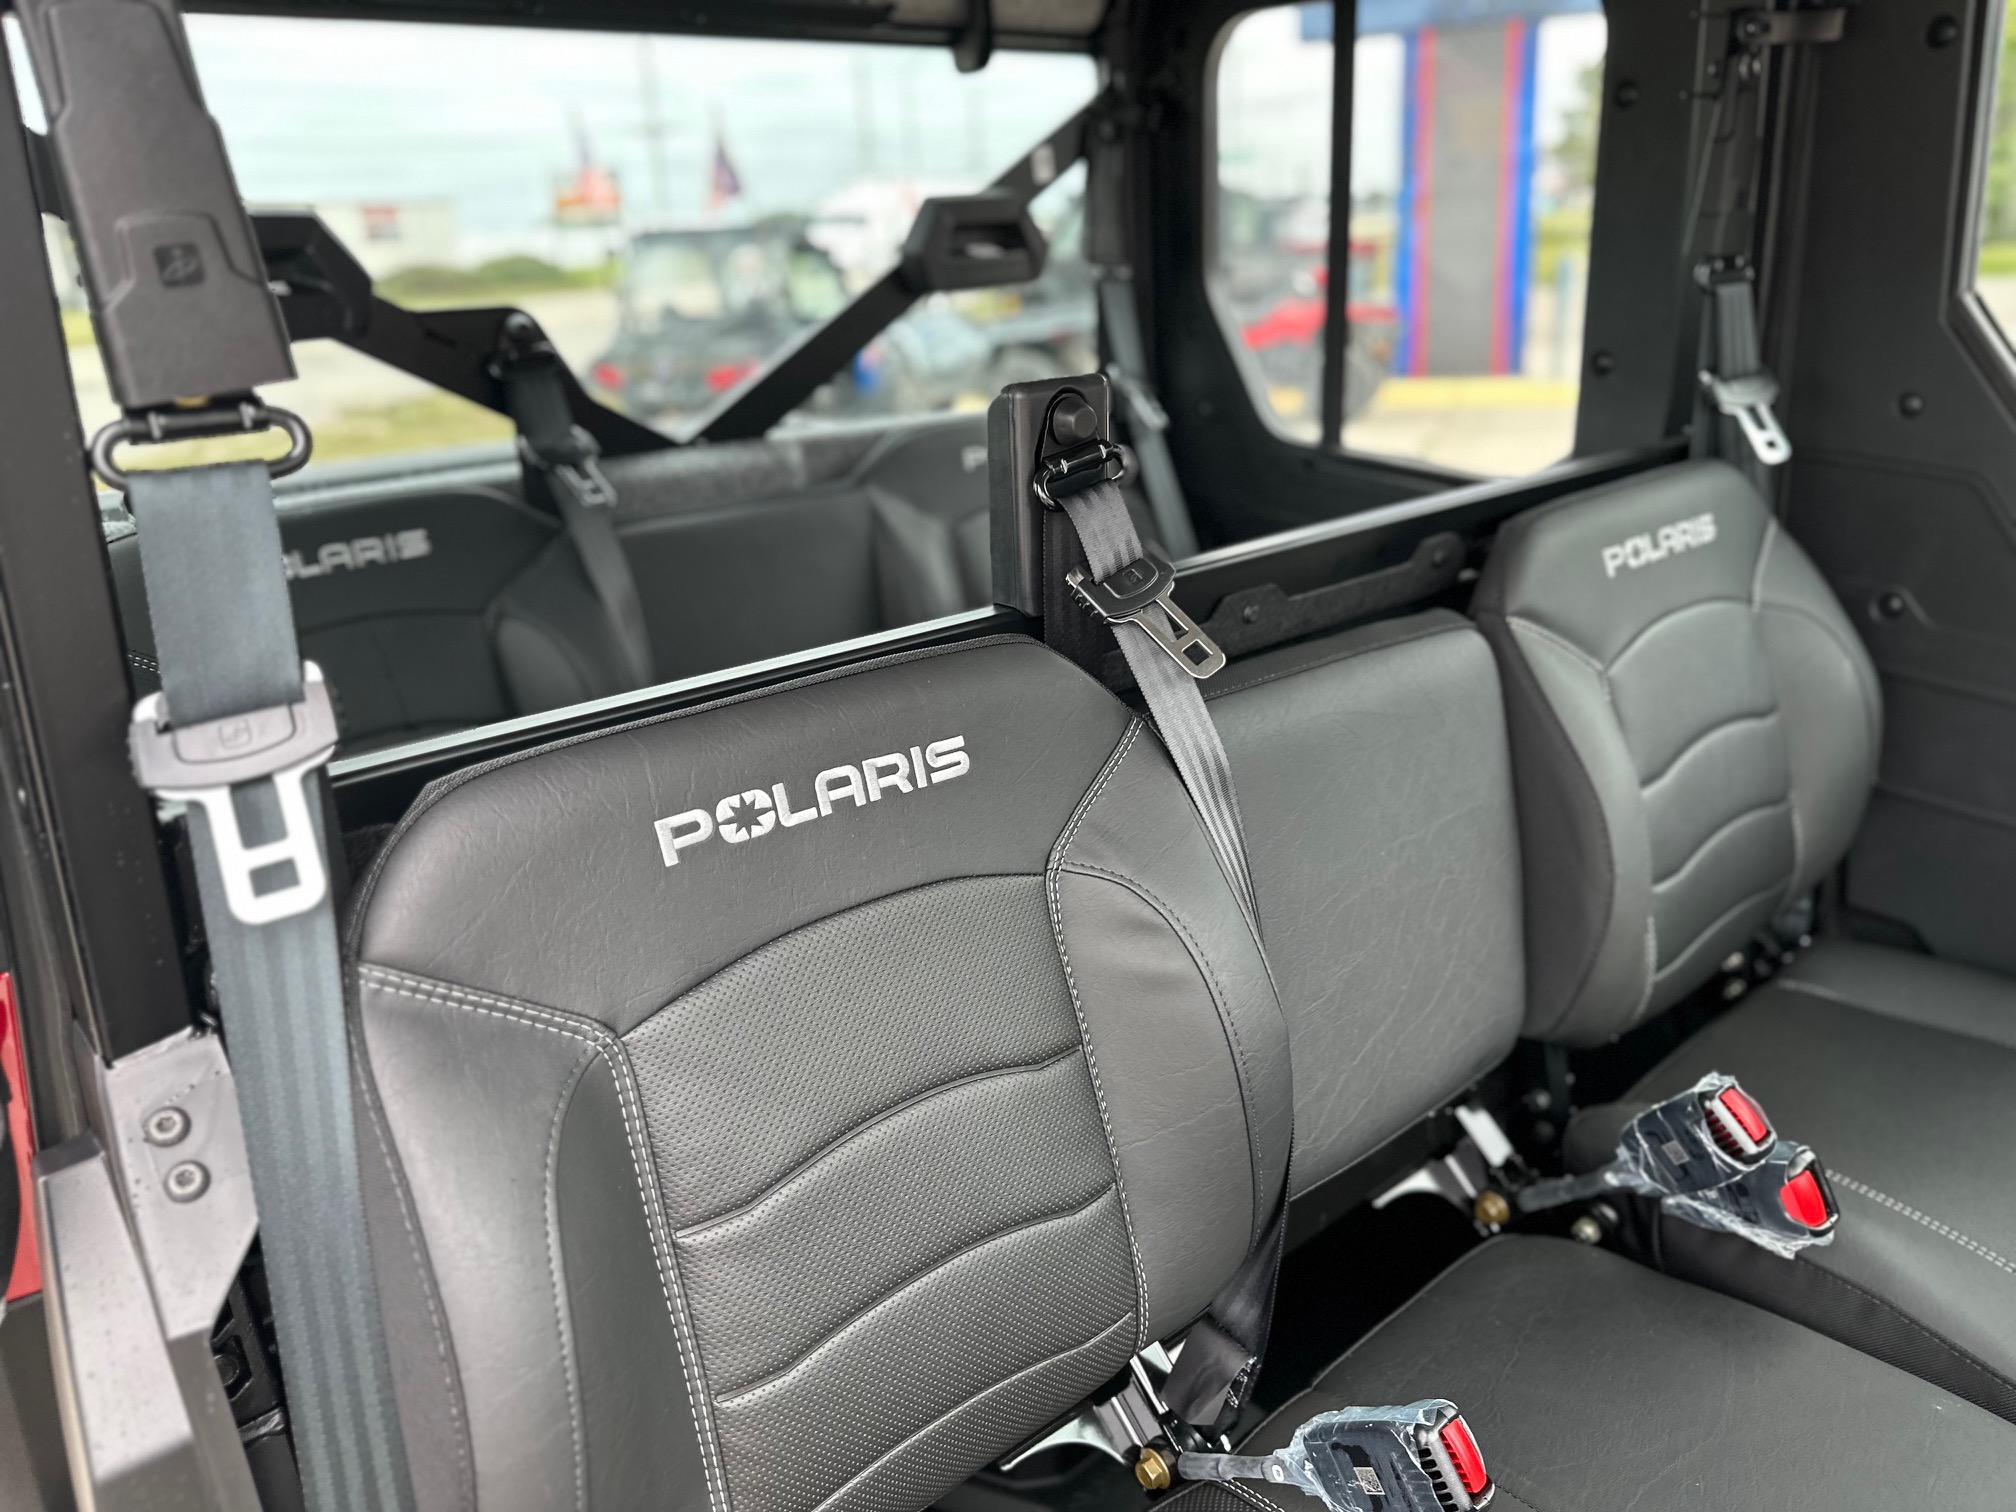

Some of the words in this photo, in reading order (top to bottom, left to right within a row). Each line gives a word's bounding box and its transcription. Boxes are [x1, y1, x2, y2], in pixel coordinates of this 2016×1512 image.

[282, 527, 432, 580] LARIS
[1601, 512, 1717, 579] POLARIS
[653, 734, 970, 867] POLARIS
